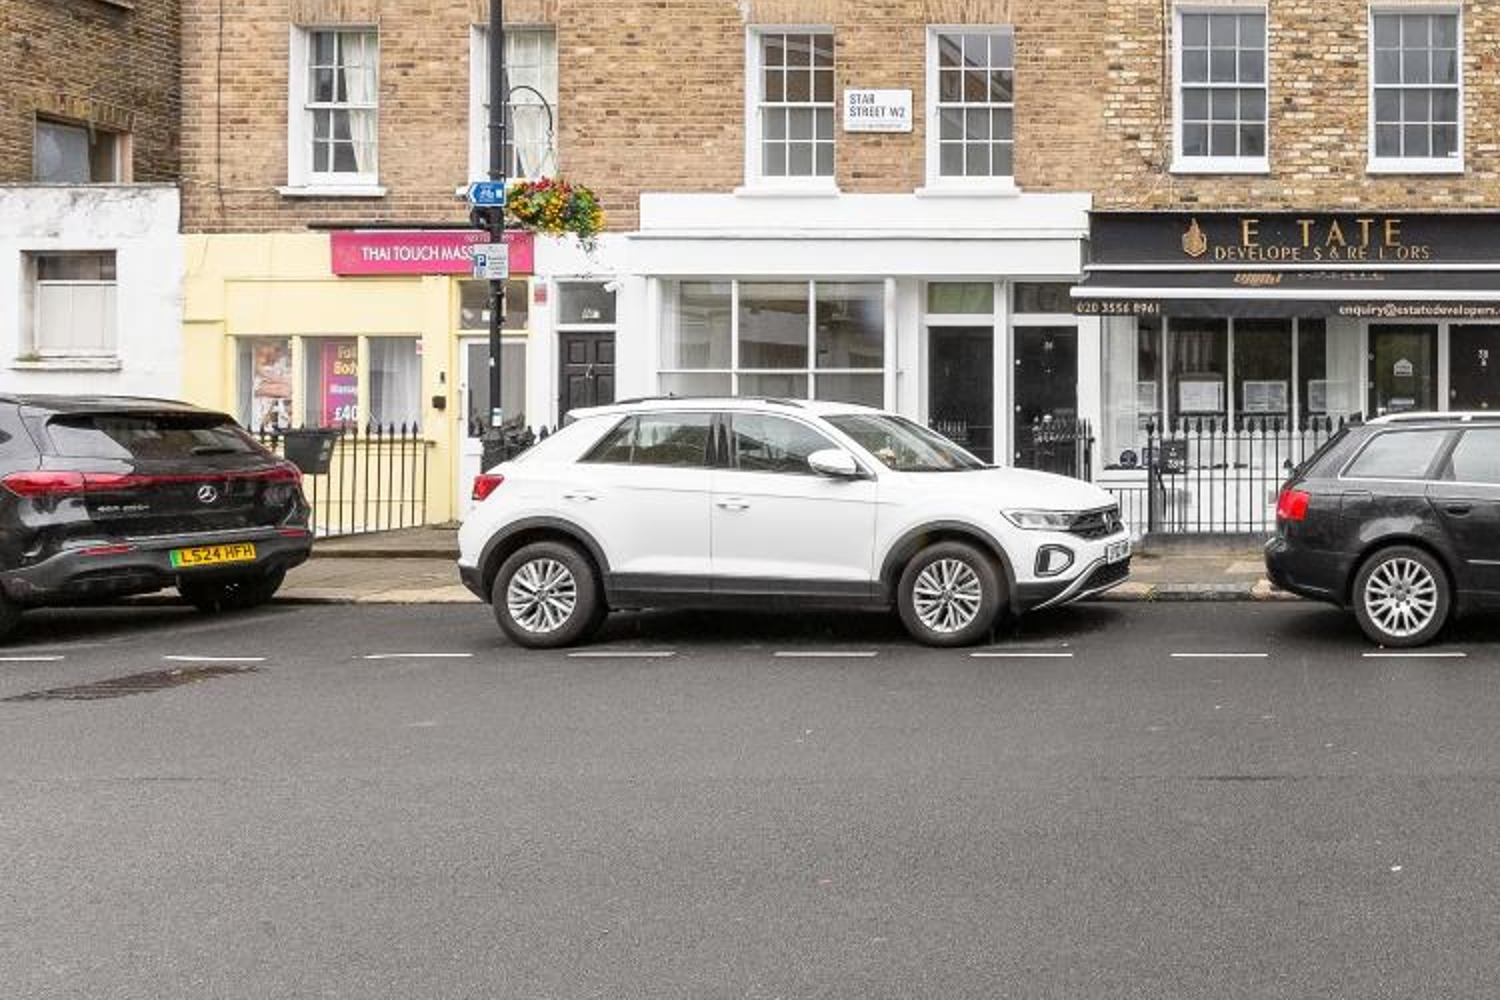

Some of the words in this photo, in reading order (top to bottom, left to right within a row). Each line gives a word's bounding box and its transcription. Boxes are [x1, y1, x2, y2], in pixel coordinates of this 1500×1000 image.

[849, 93, 875, 104] STAR
[849, 105, 886, 117] STREET
[889, 106, 905, 118] W2
[360, 246, 391, 261] THAI
[392, 245, 440, 261] TOUCH
[441, 244, 475, 261] MASS
[1214, 246, 1321, 260] DEVELOPES
[1076, 301, 1099, 313] 020
[181, 550, 221, 563] LS24
